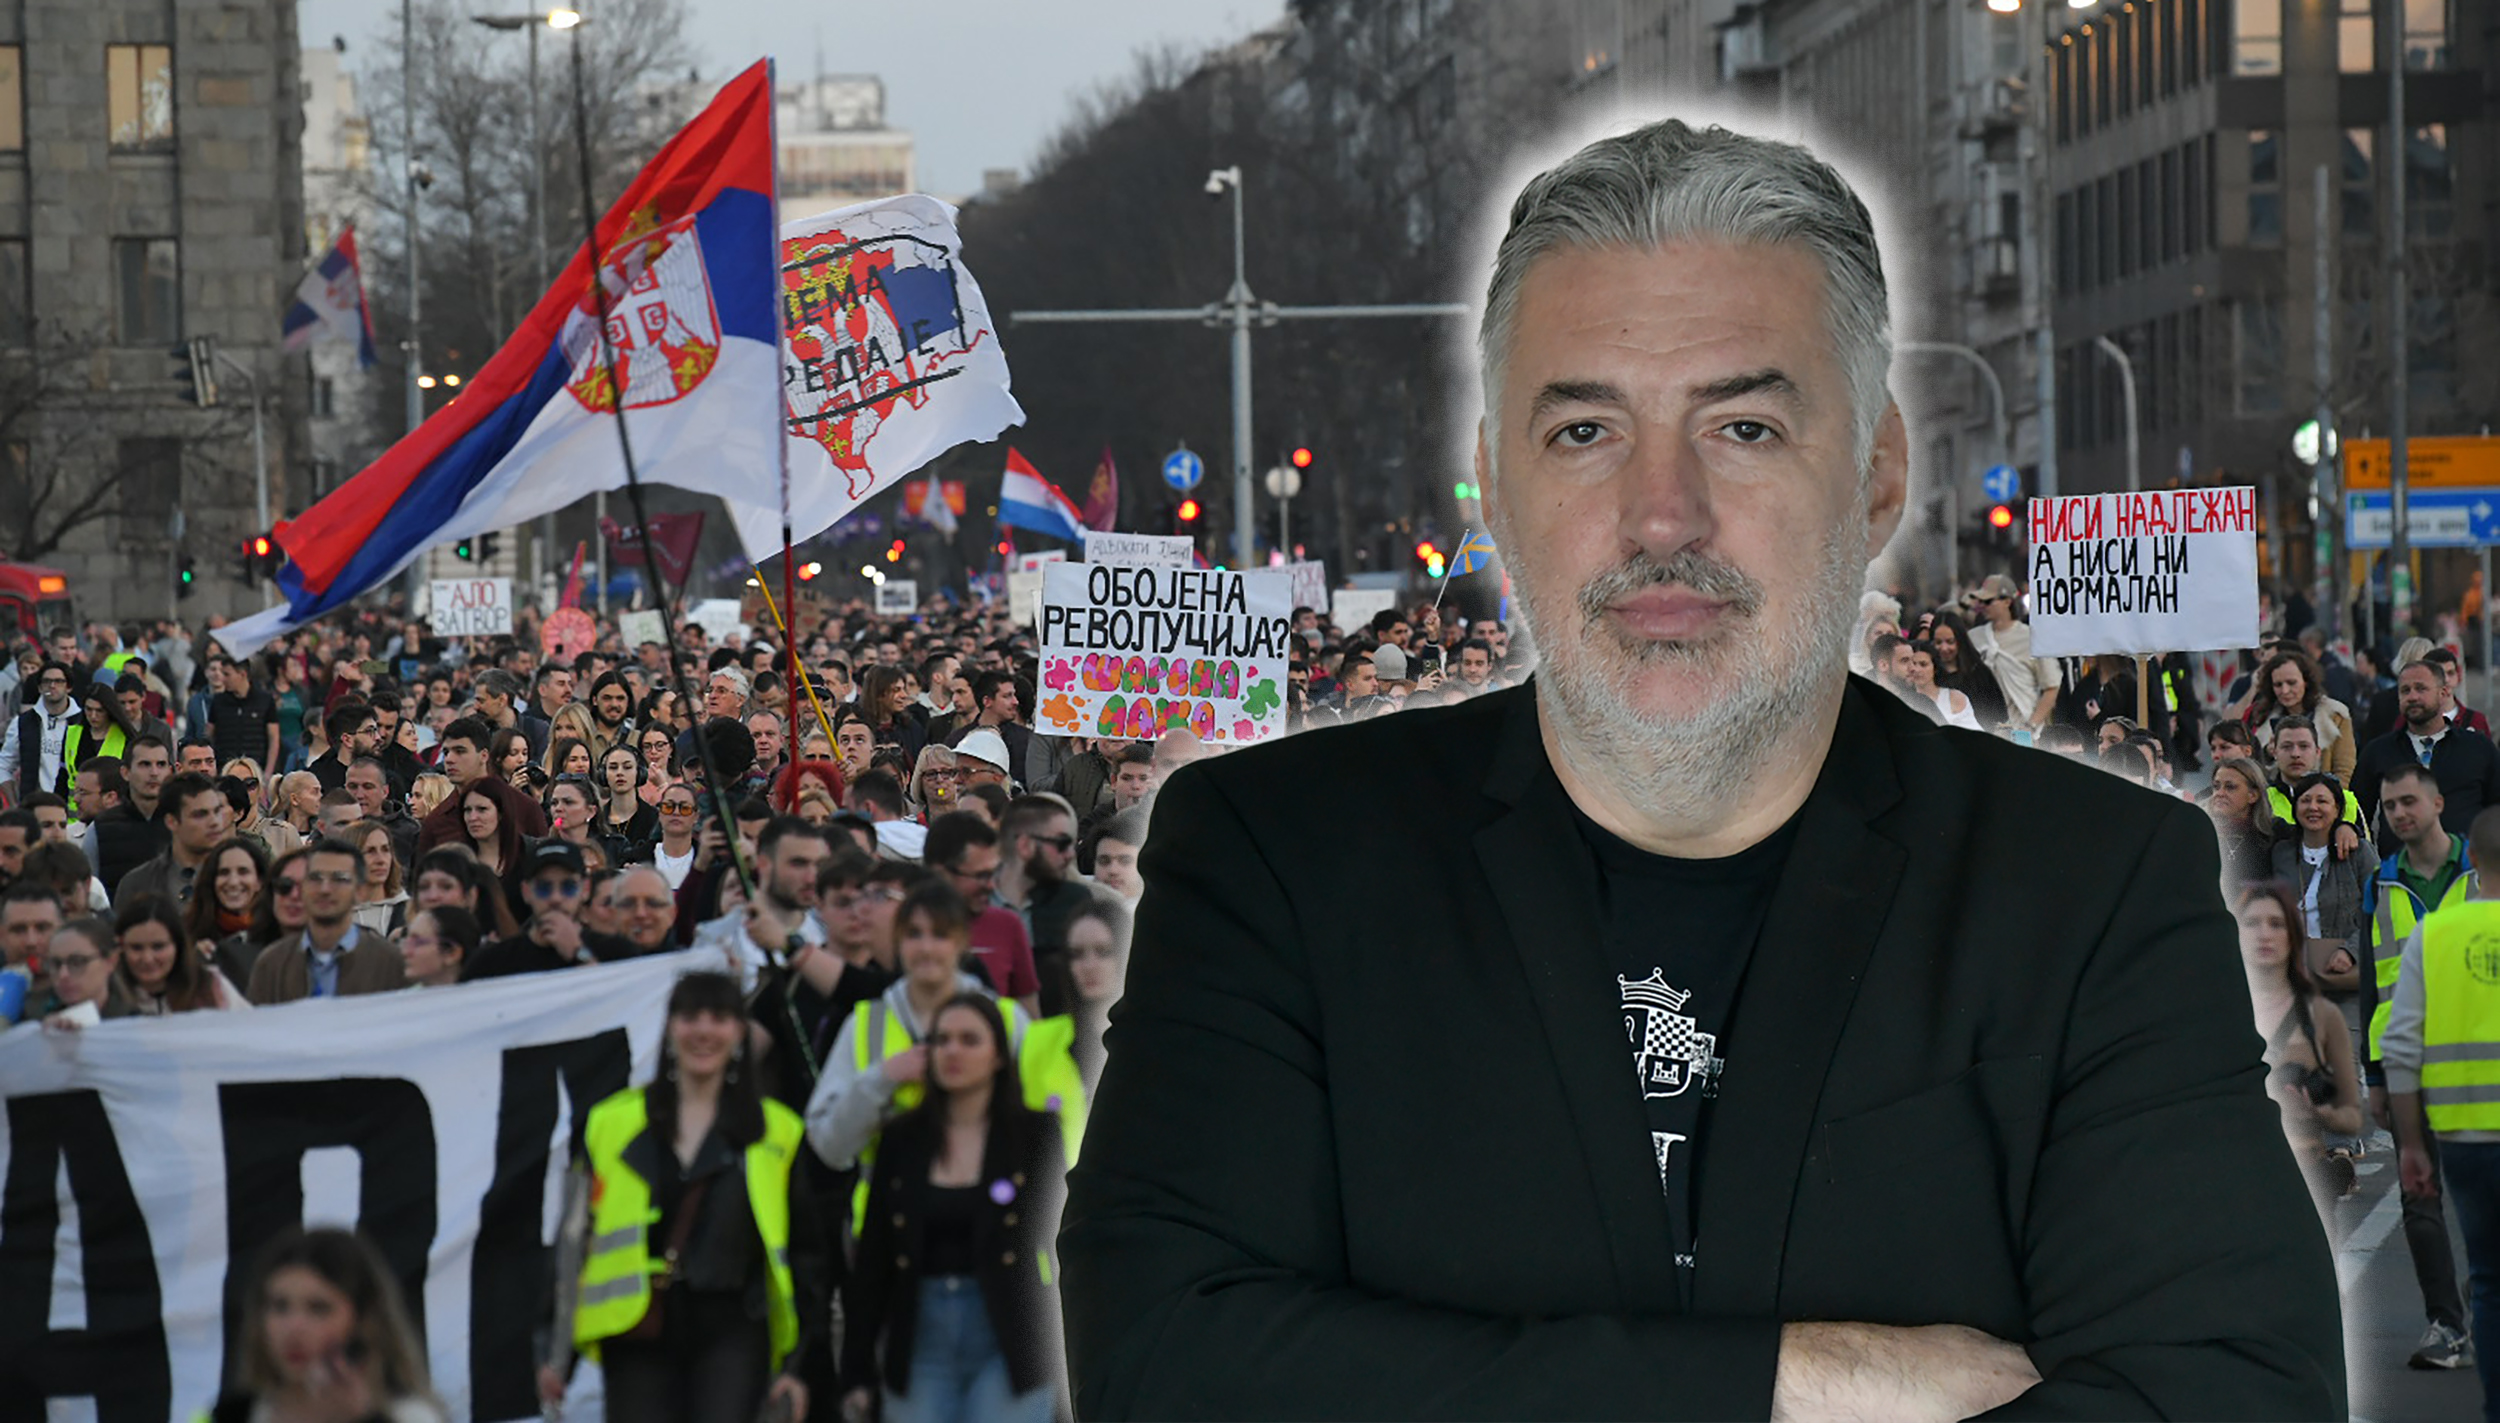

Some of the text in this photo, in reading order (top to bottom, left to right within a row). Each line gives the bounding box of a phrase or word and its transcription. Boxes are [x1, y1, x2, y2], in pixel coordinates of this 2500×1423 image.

[2033, 489, 2254, 544] НИСИ НАДЛЕЖАН
[2034, 535, 2188, 579] А НИСИ НИ
[450, 581, 495, 608] АЛО
[1089, 566, 1246, 614] ОБОЈЕНА
[2037, 575, 2178, 615] НОРМАЛАН
[433, 606, 508, 635] ЗАТВОР
[1042, 605, 1290, 659] РЕВОЛУЦИЈА?
[1082, 653, 1240, 699] ШАРЕНА
